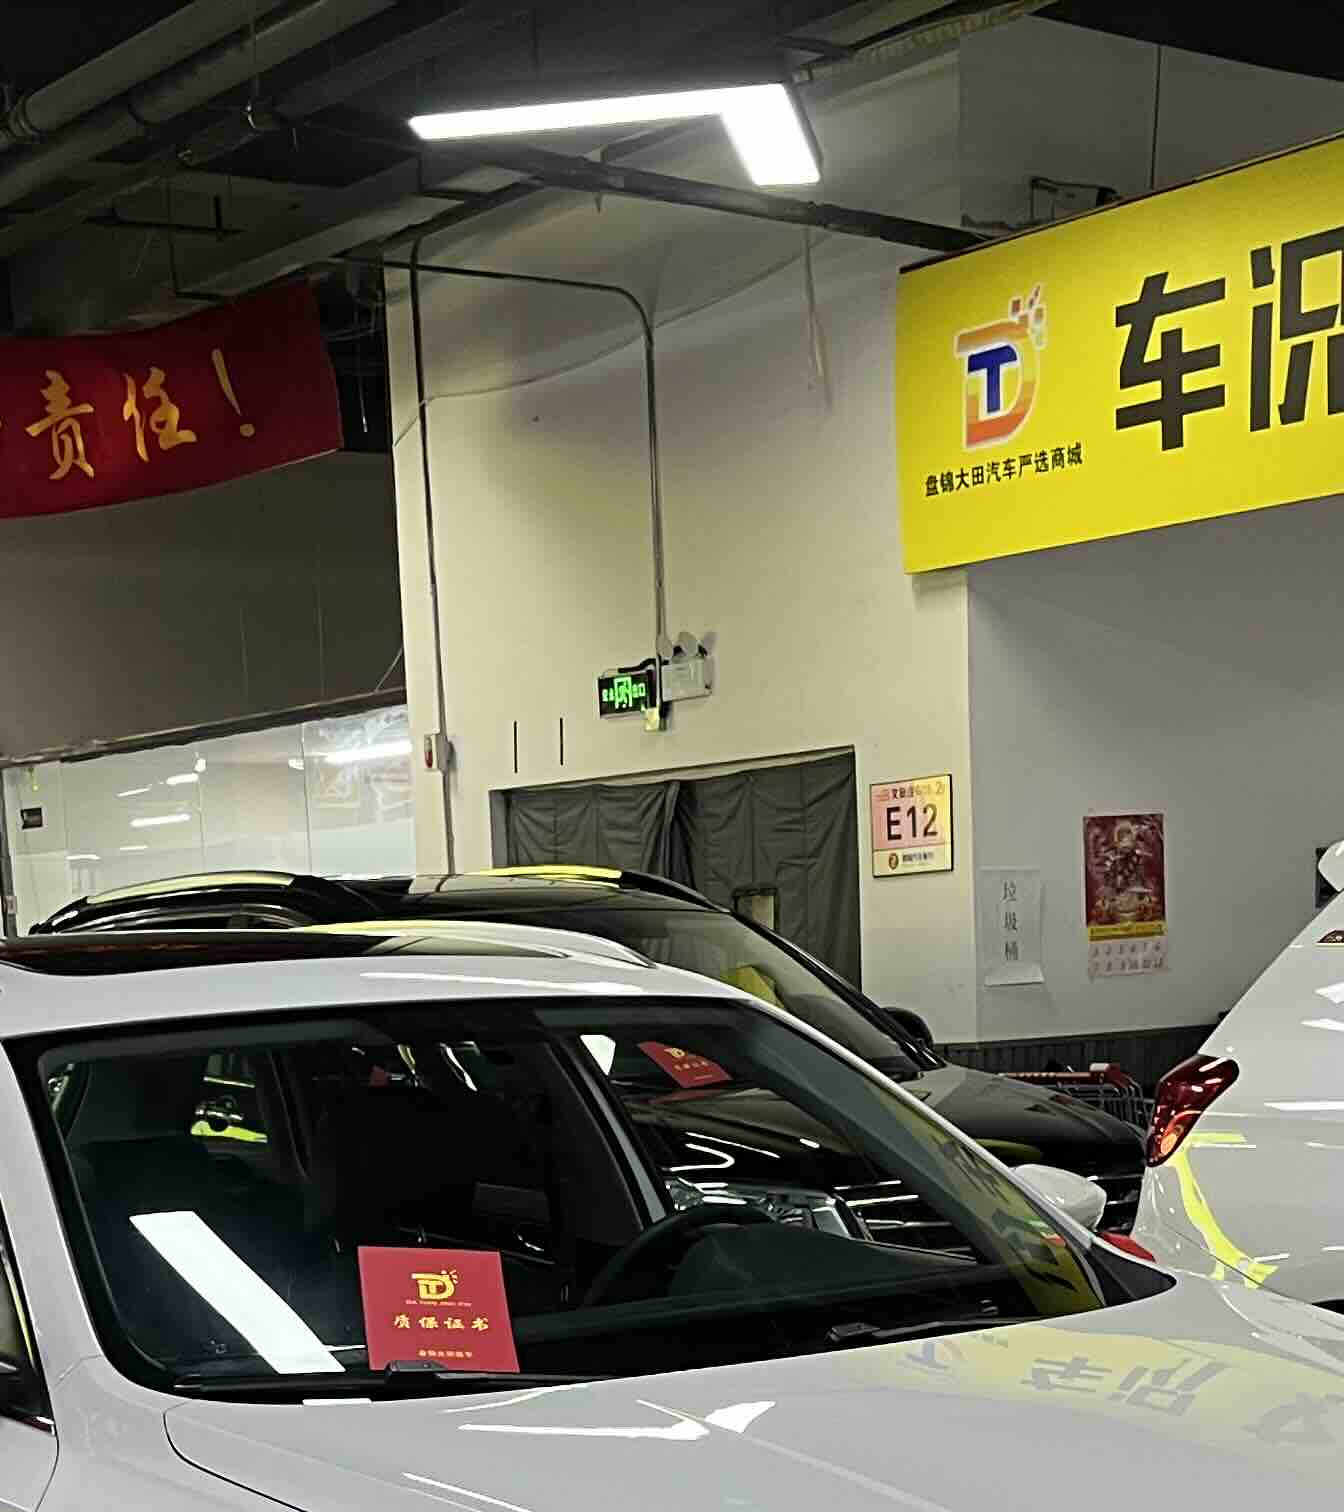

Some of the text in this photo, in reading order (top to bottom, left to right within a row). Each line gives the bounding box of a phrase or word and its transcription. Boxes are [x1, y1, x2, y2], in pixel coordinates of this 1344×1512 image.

[925, 443, 1083, 497] 盘锦大田汽车严选商城
[887, 803, 939, 842] E12
[394, 1313, 489, 1331] 质保证书
